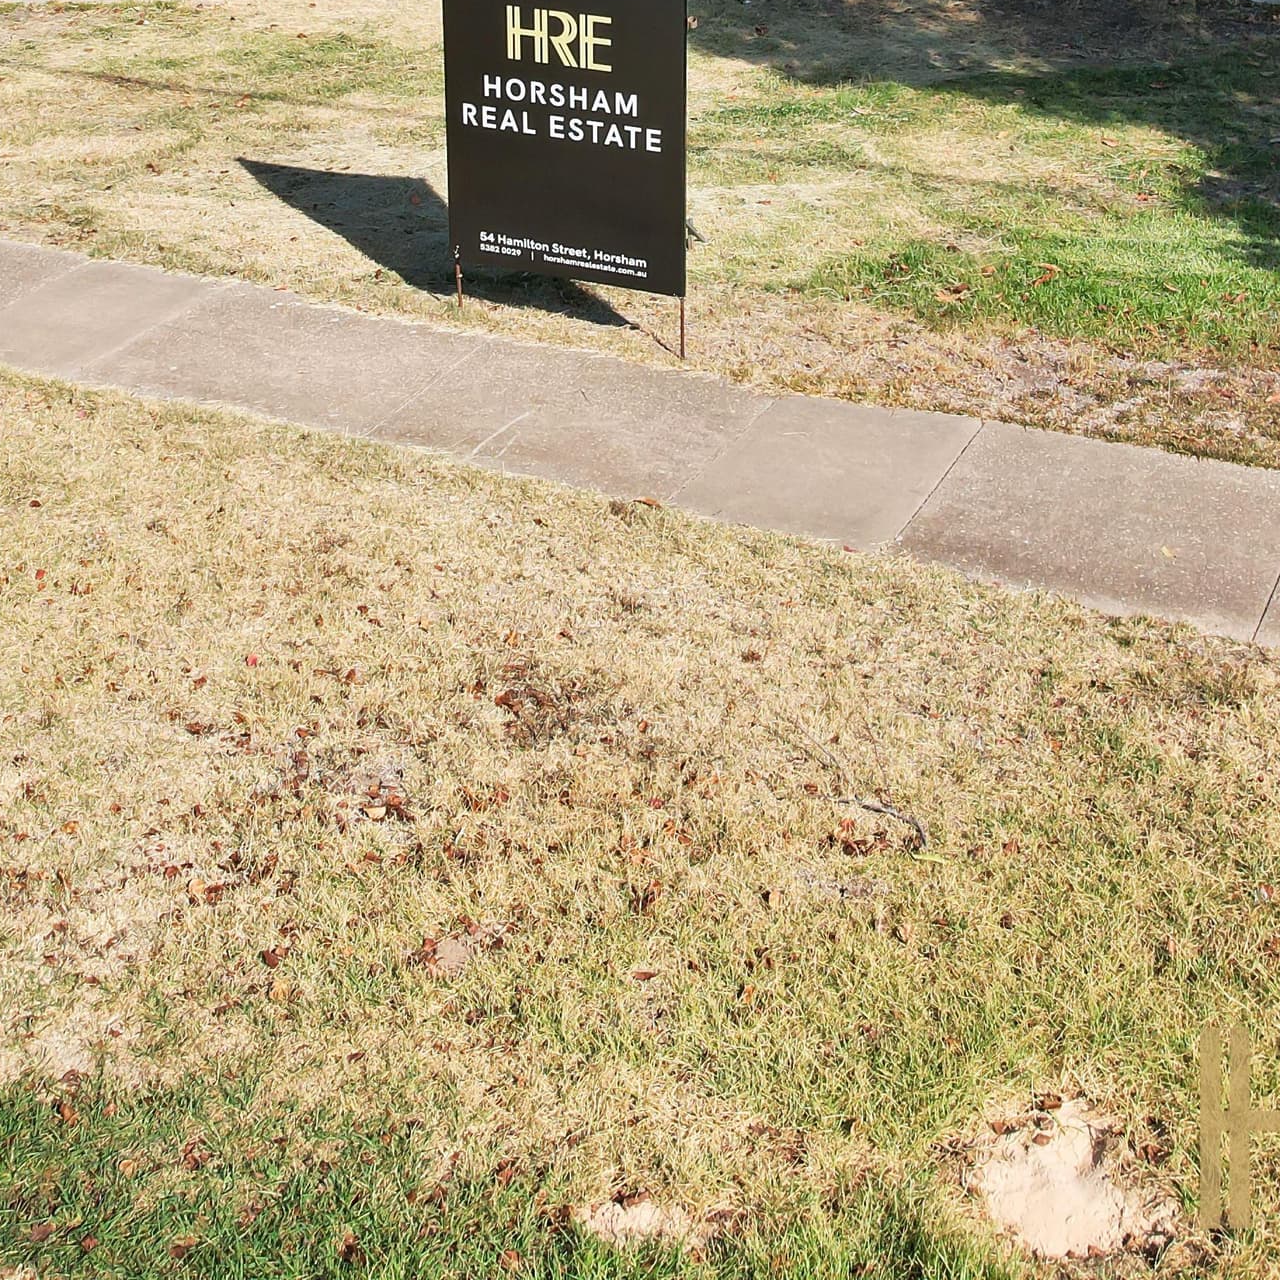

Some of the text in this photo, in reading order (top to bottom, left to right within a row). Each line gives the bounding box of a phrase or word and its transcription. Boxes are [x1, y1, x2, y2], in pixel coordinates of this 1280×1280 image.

[506, 4, 612, 72] HRE
[483, 74, 638, 117] HORSHAM
[462, 102, 662, 153] REAL ESTATE
[480, 231, 647, 268] 54 Hamilton Street, Horsham
[480, 243, 647, 278] 5382 0029 horshamrealestate.com.au
